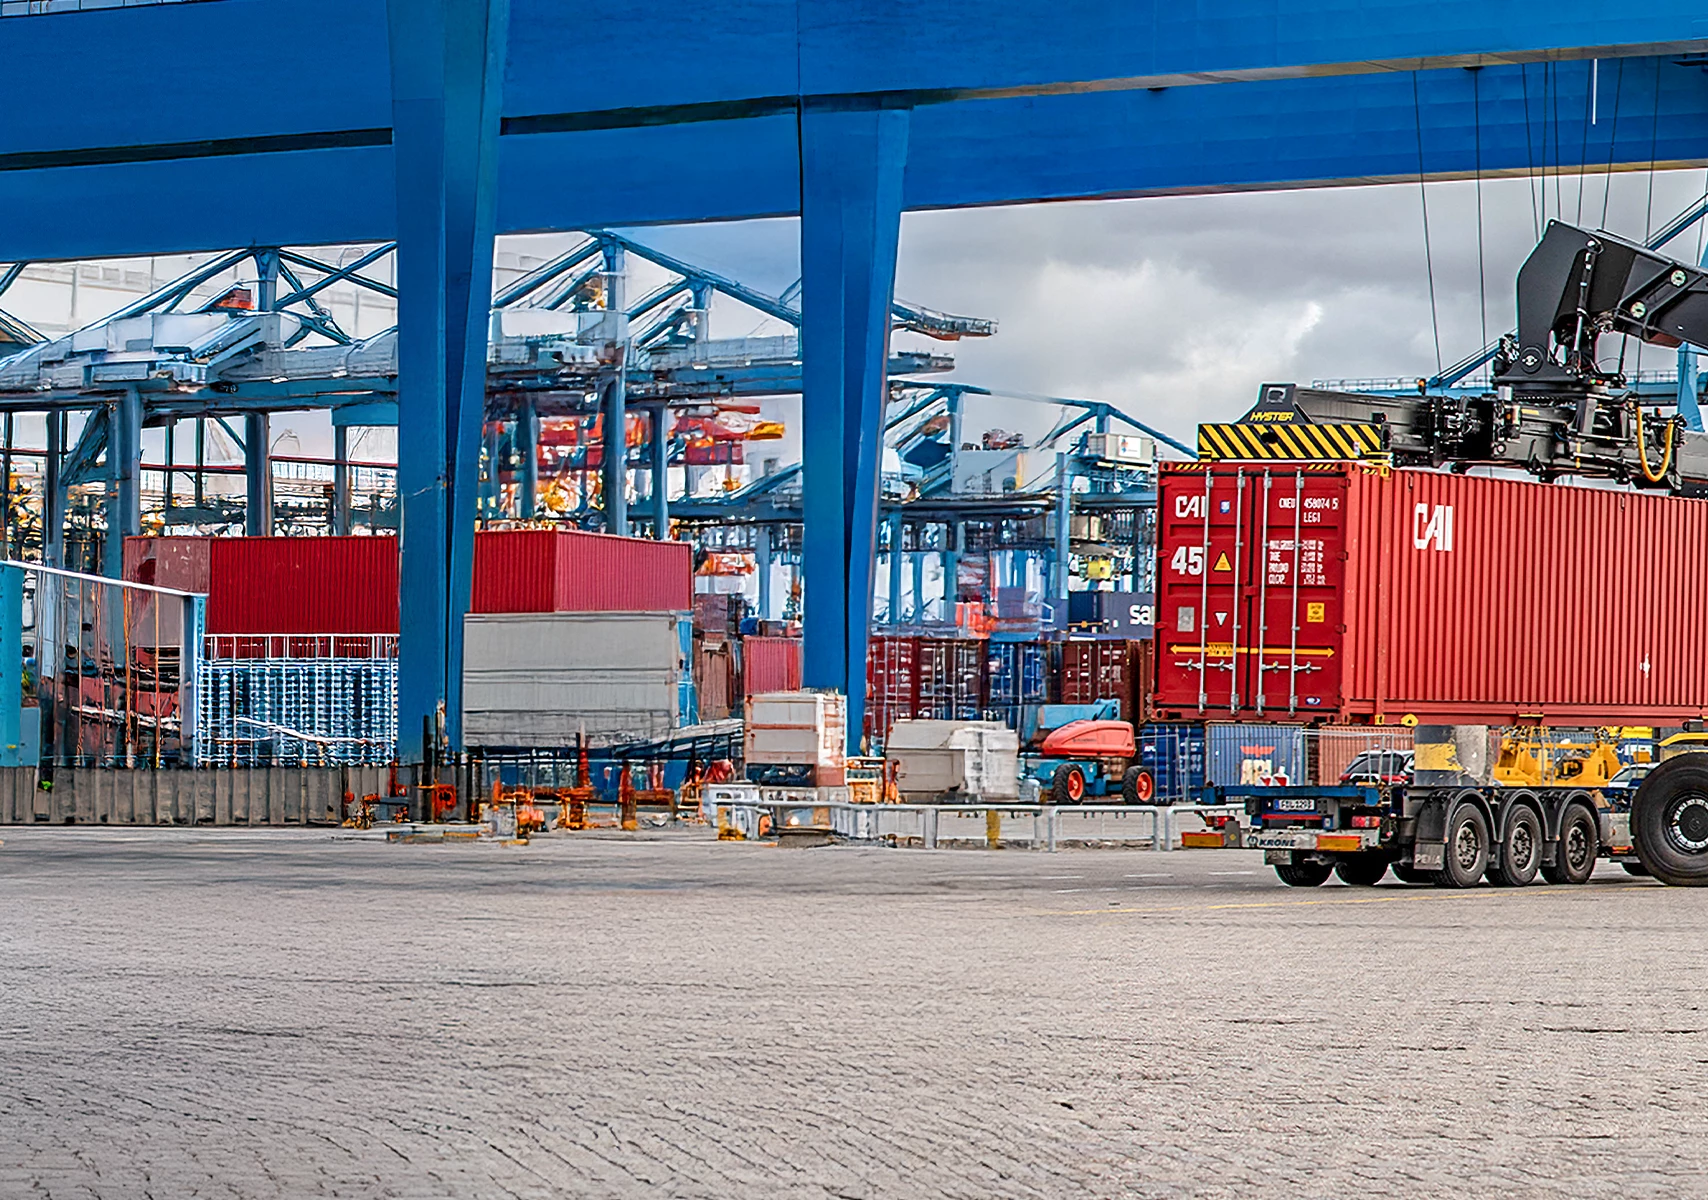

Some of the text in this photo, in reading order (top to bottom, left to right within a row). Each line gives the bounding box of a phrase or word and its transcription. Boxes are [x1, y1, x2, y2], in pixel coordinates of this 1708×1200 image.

[1250, 411, 1295, 421] HYSTER
[1413, 502, 1454, 552] CAI
[1171, 547, 1204, 575] 45
[1259, 839, 1297, 847] KRONE
